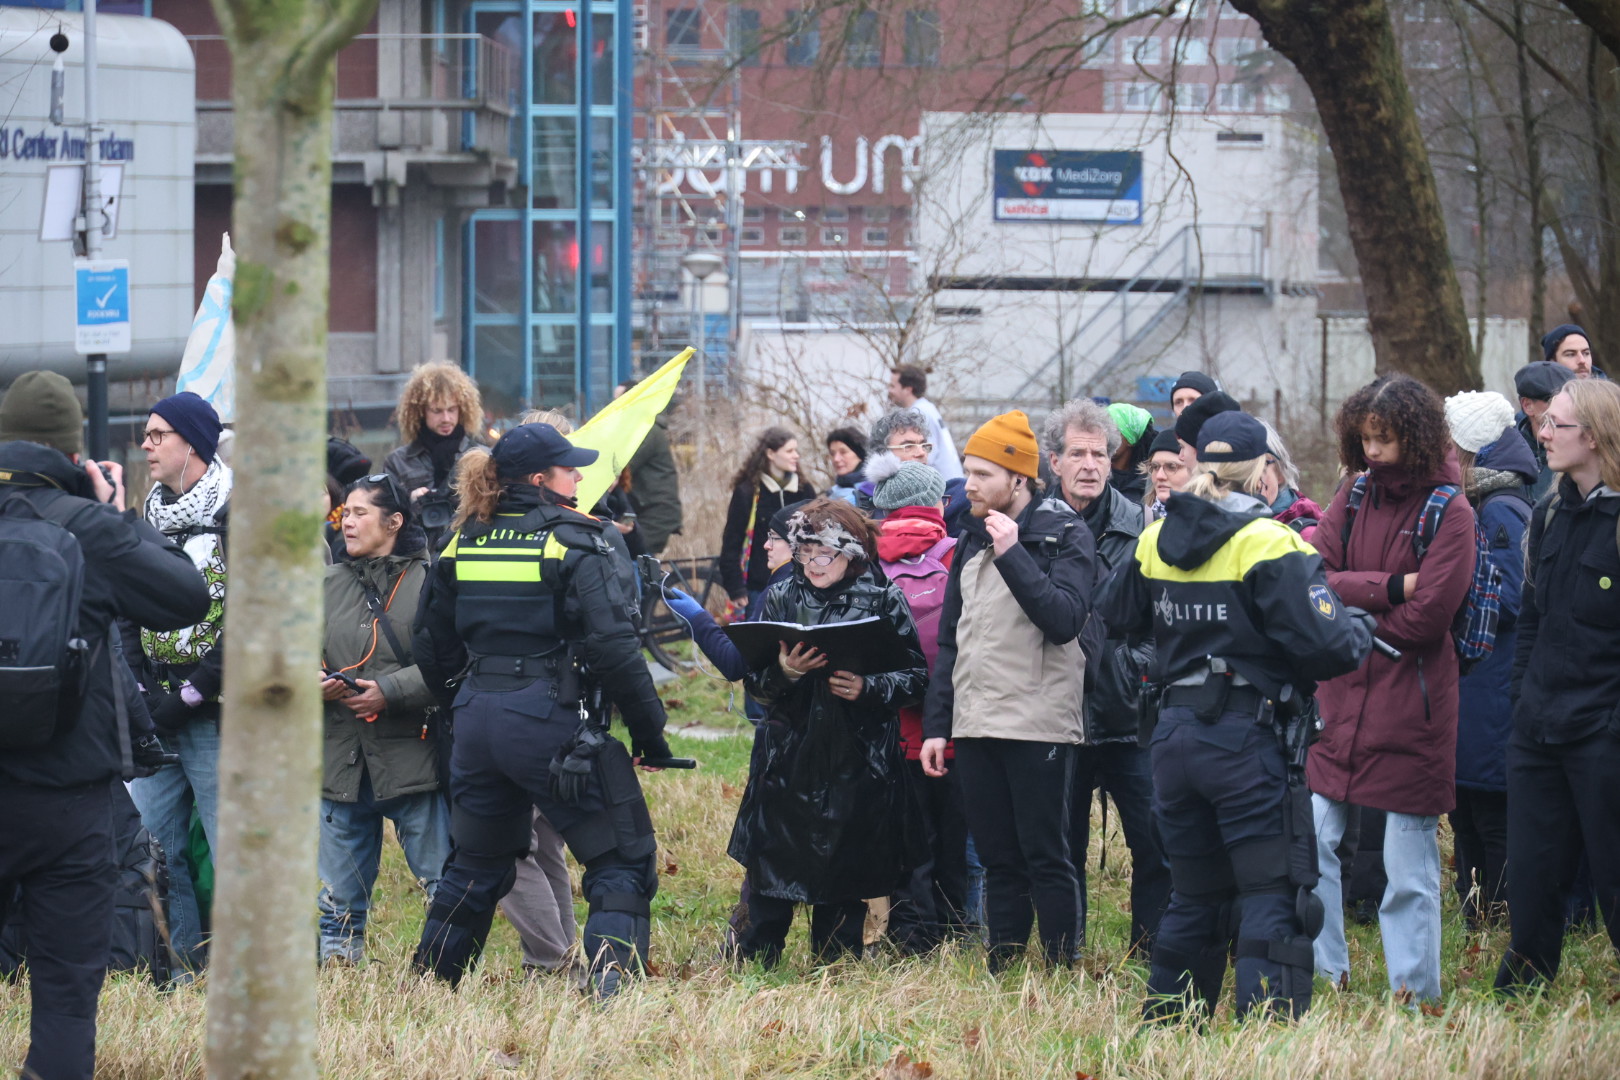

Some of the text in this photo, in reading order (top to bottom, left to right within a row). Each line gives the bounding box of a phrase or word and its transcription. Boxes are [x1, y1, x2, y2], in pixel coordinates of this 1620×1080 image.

[13, 127, 58, 160] Center
[60, 129, 135, 161] Amsrdam
[1056, 167, 1122, 187] MediZorg
